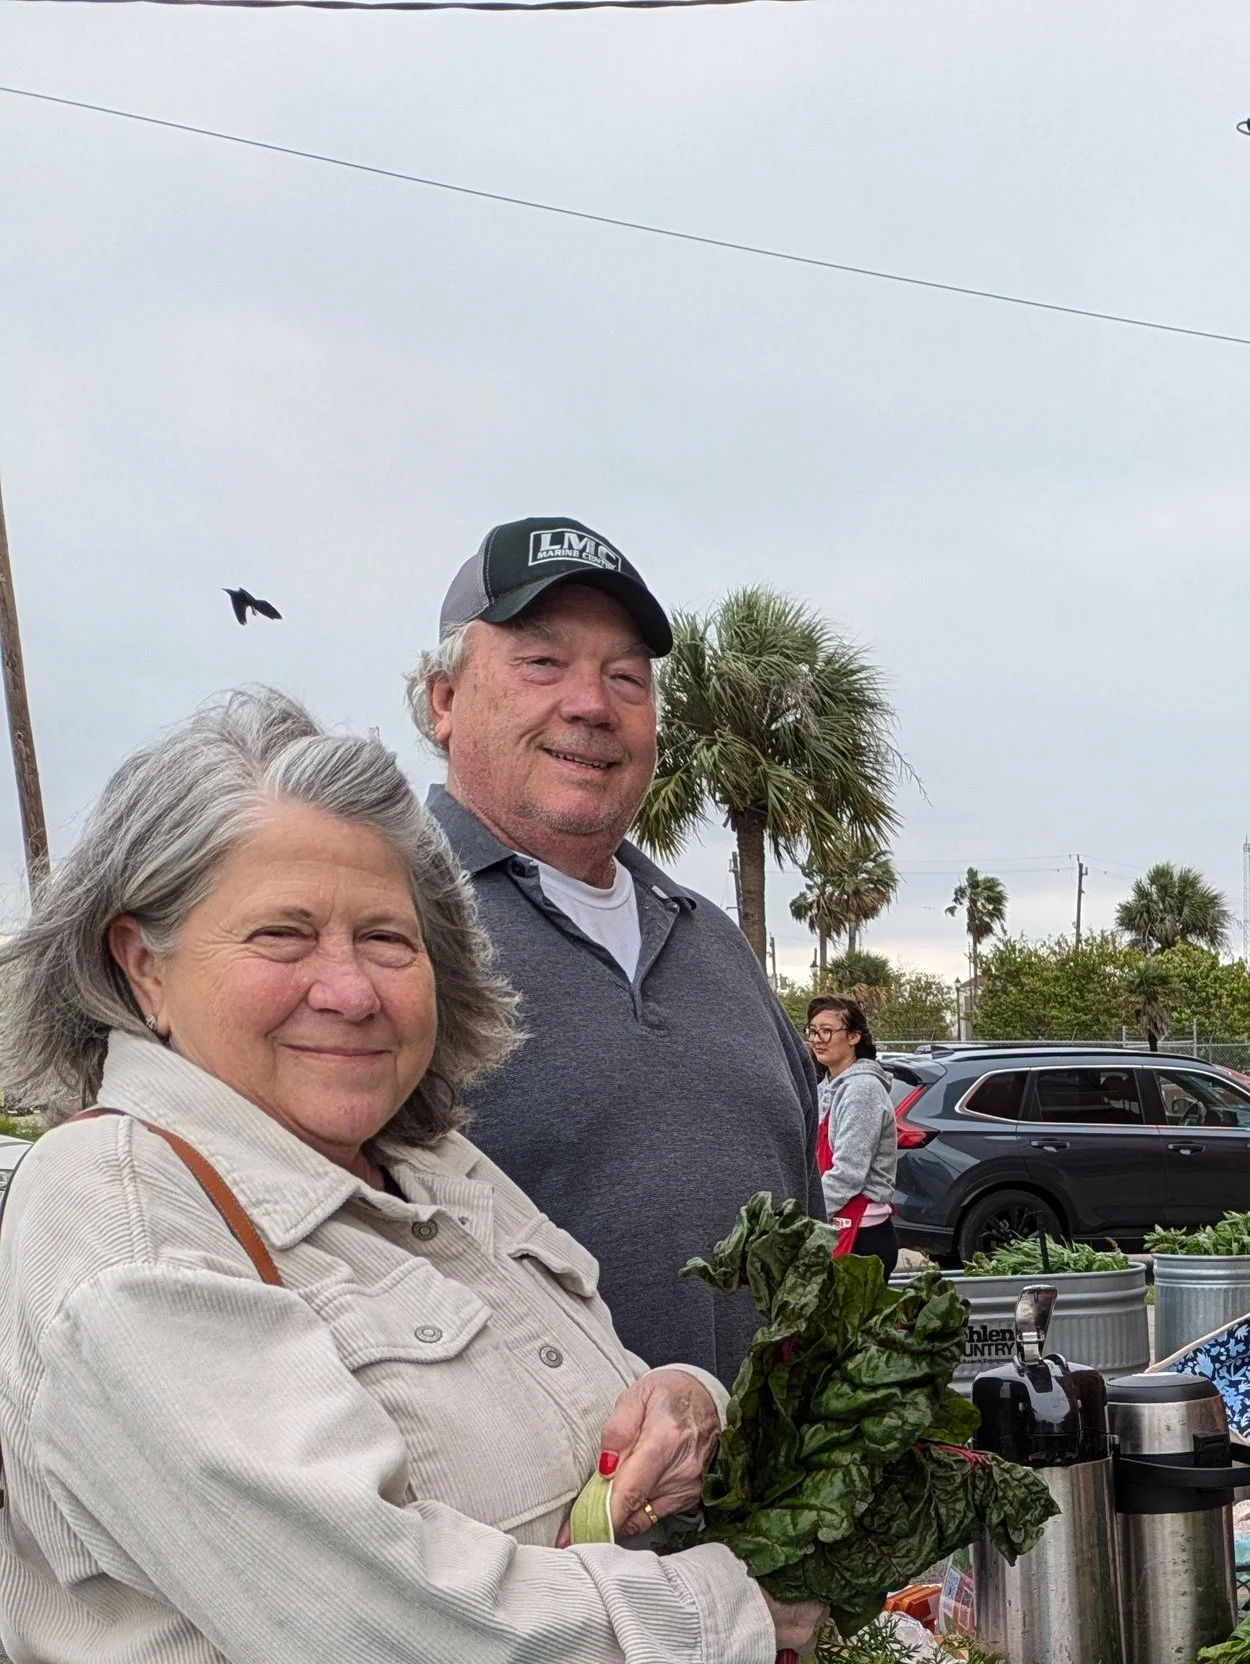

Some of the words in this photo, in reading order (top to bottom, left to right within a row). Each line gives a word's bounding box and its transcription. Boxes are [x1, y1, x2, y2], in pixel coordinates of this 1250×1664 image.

[537, 549, 580, 559] MARINE
[540, 532, 616, 569] LMC
[964, 1325, 1015, 1343] hlen
[963, 1342, 1016, 1357] UNTRY
